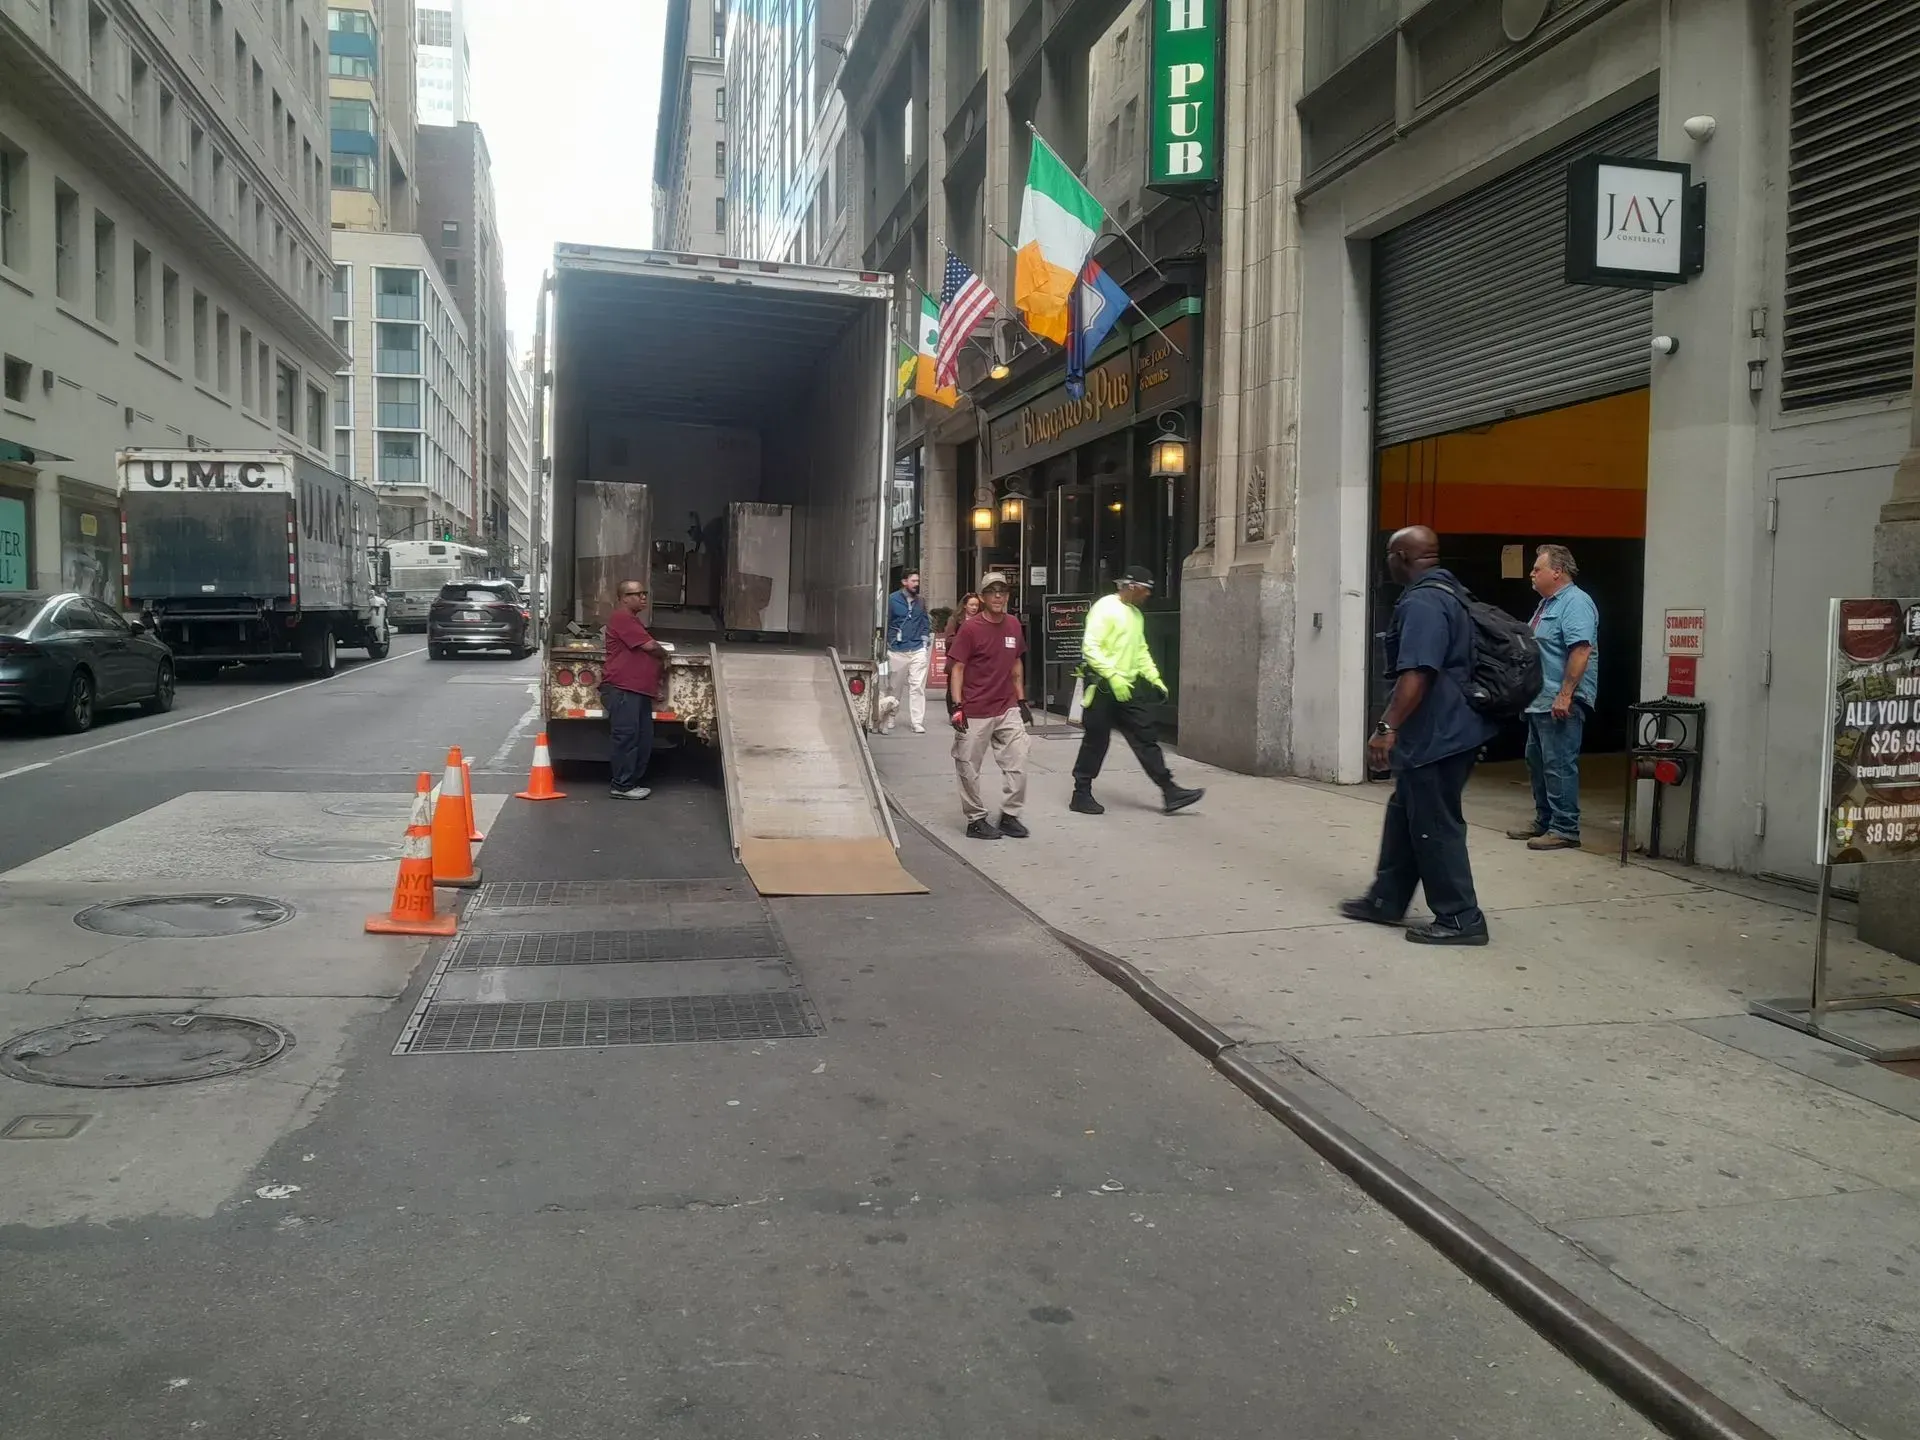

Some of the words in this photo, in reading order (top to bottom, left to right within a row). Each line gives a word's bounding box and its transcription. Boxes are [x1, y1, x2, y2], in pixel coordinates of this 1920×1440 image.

[1165, 63, 1205, 176] PUB
[1603, 193, 1675, 241] JAY
[144, 460, 273, 489] U.M.C.
[1666, 616, 1704, 629] STANDPIPE
[1669, 635, 1699, 648] SIAMESE
[1896, 677, 1920, 695] HOT
[1845, 702, 1873, 726] ALL
[1877, 700, 1909, 725] YOU
[1857, 765, 1897, 778] Everyday
[1848, 808, 1862, 820] ALL
[1864, 806, 1881, 819] YOU
[1883, 806, 1900, 819] CAN
[1866, 822, 1903, 844] $8.99
